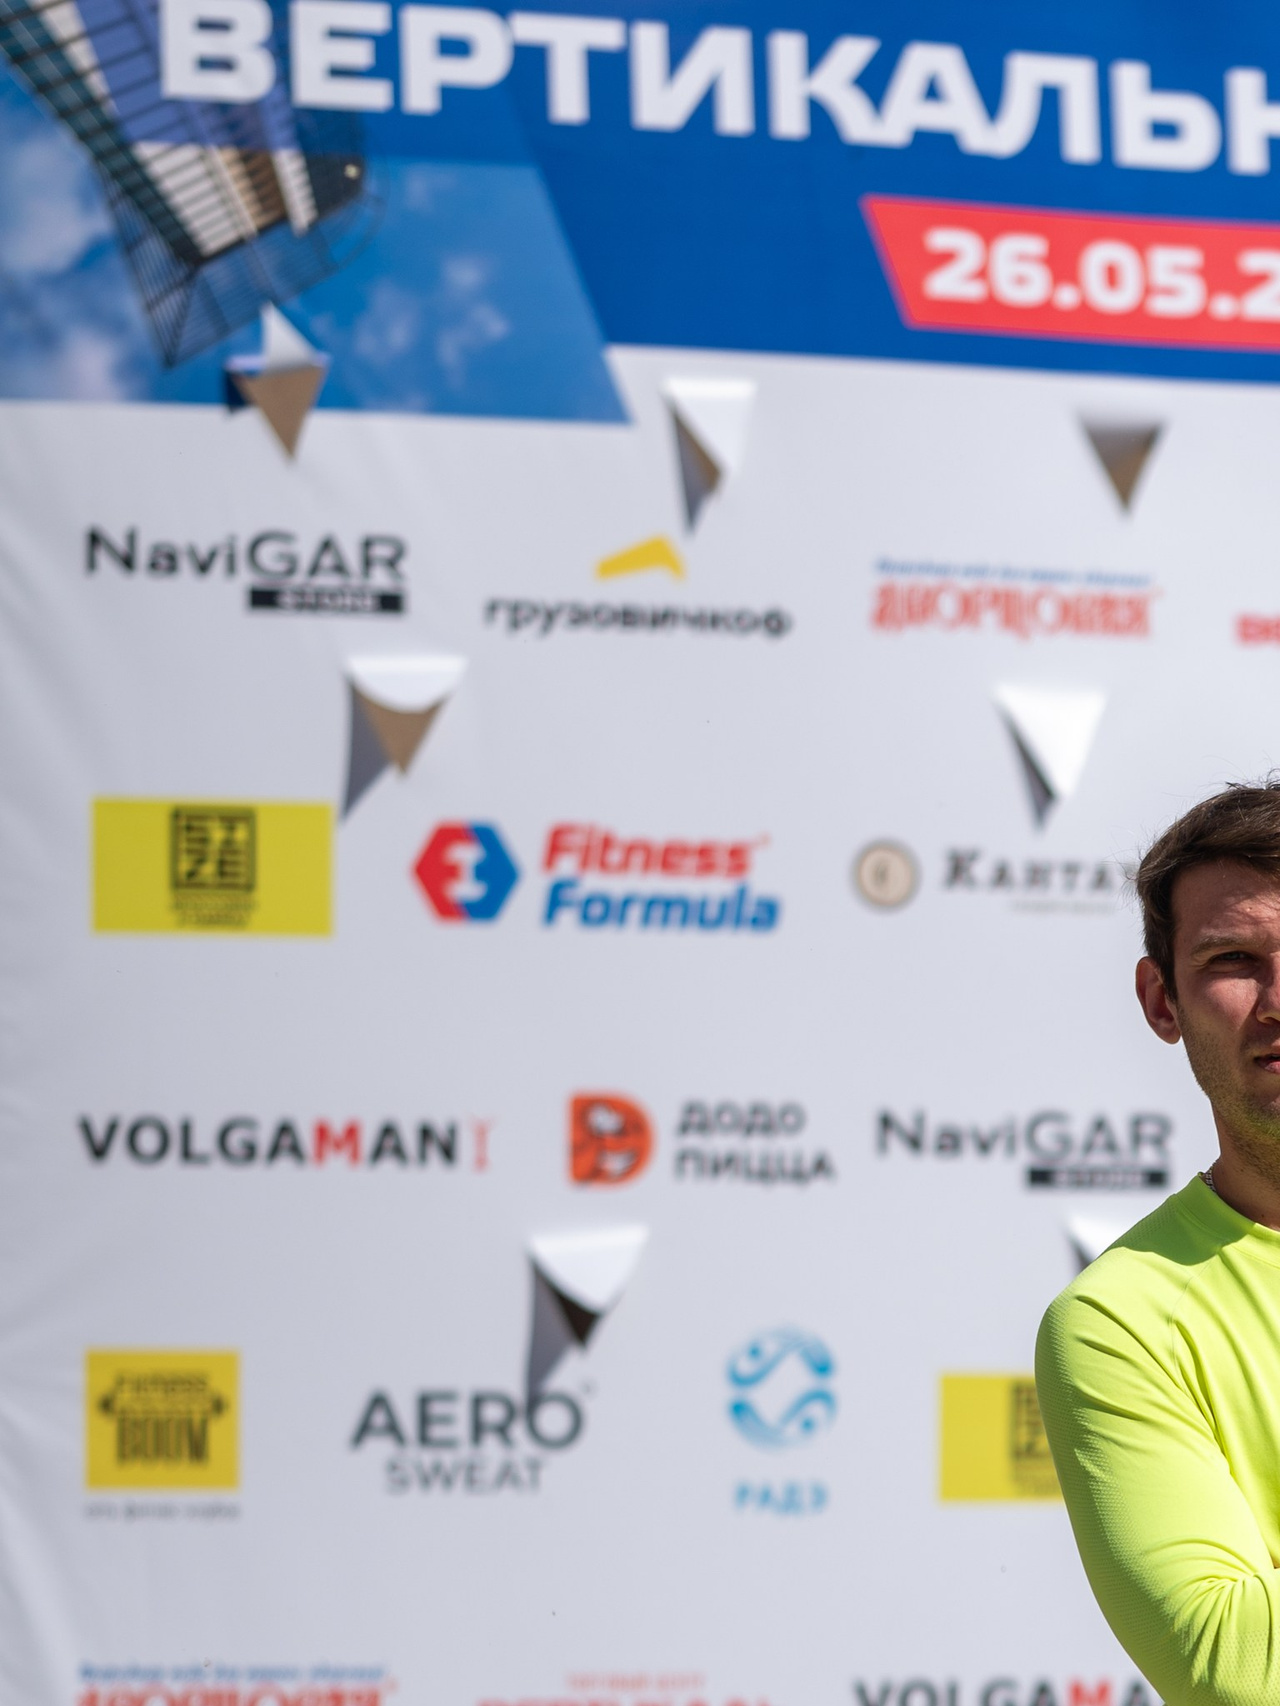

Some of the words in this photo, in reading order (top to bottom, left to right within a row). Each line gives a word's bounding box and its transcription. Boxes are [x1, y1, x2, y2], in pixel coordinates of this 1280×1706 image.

[83, 525, 408, 582] NaviGAR
[540, 822, 755, 882] Fitness
[540, 878, 780, 932] Formula
[78, 1112, 462, 1172] VOLGAMAN
[675, 1100, 806, 1140] ДОДО
[873, 1108, 1174, 1162] NaviGAR
[673, 1146, 836, 1187] ПИЦЦА
[350, 1390, 586, 1452] AERO
[384, 1455, 548, 1495] SWEAT
